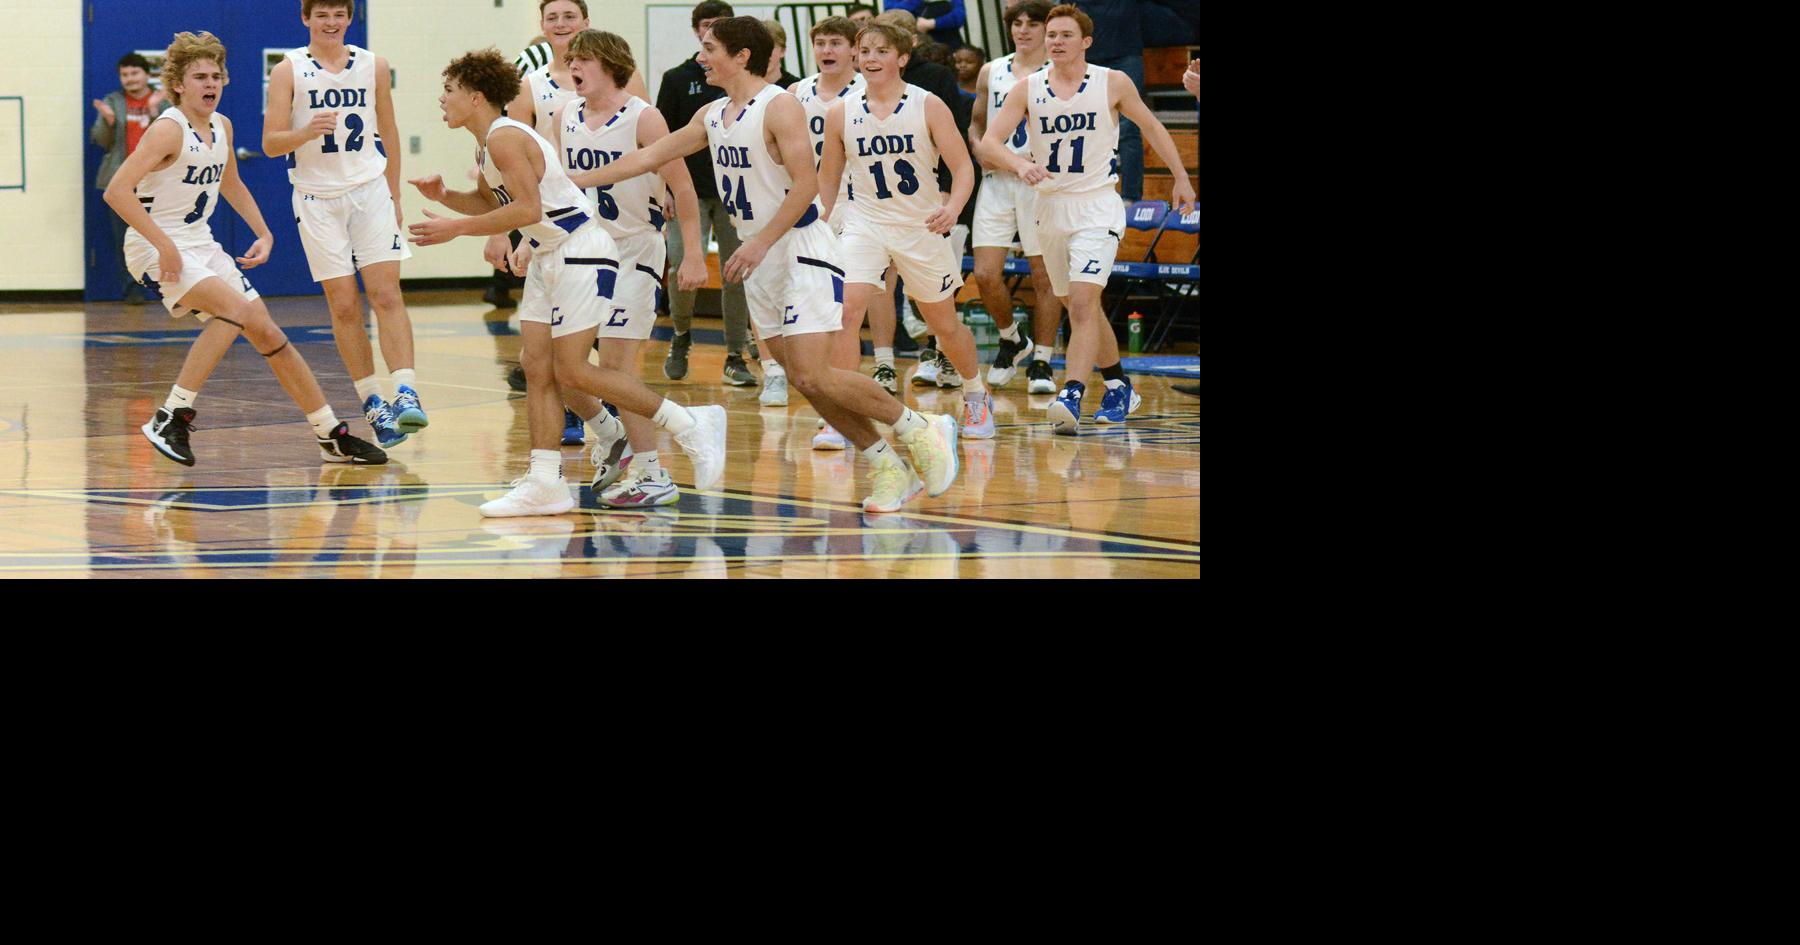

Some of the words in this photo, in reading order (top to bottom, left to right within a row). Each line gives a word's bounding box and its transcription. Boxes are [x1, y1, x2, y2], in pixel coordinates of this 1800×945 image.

[308, 88, 366, 109] LODI
[1039, 112, 1097, 134] LODI
[856, 134, 915, 156] LODI
[1045, 136, 1085, 173] 11
[869, 158, 919, 200] 13
[722, 174, 753, 220] 24
[1134, 207, 1155, 221] LODI
